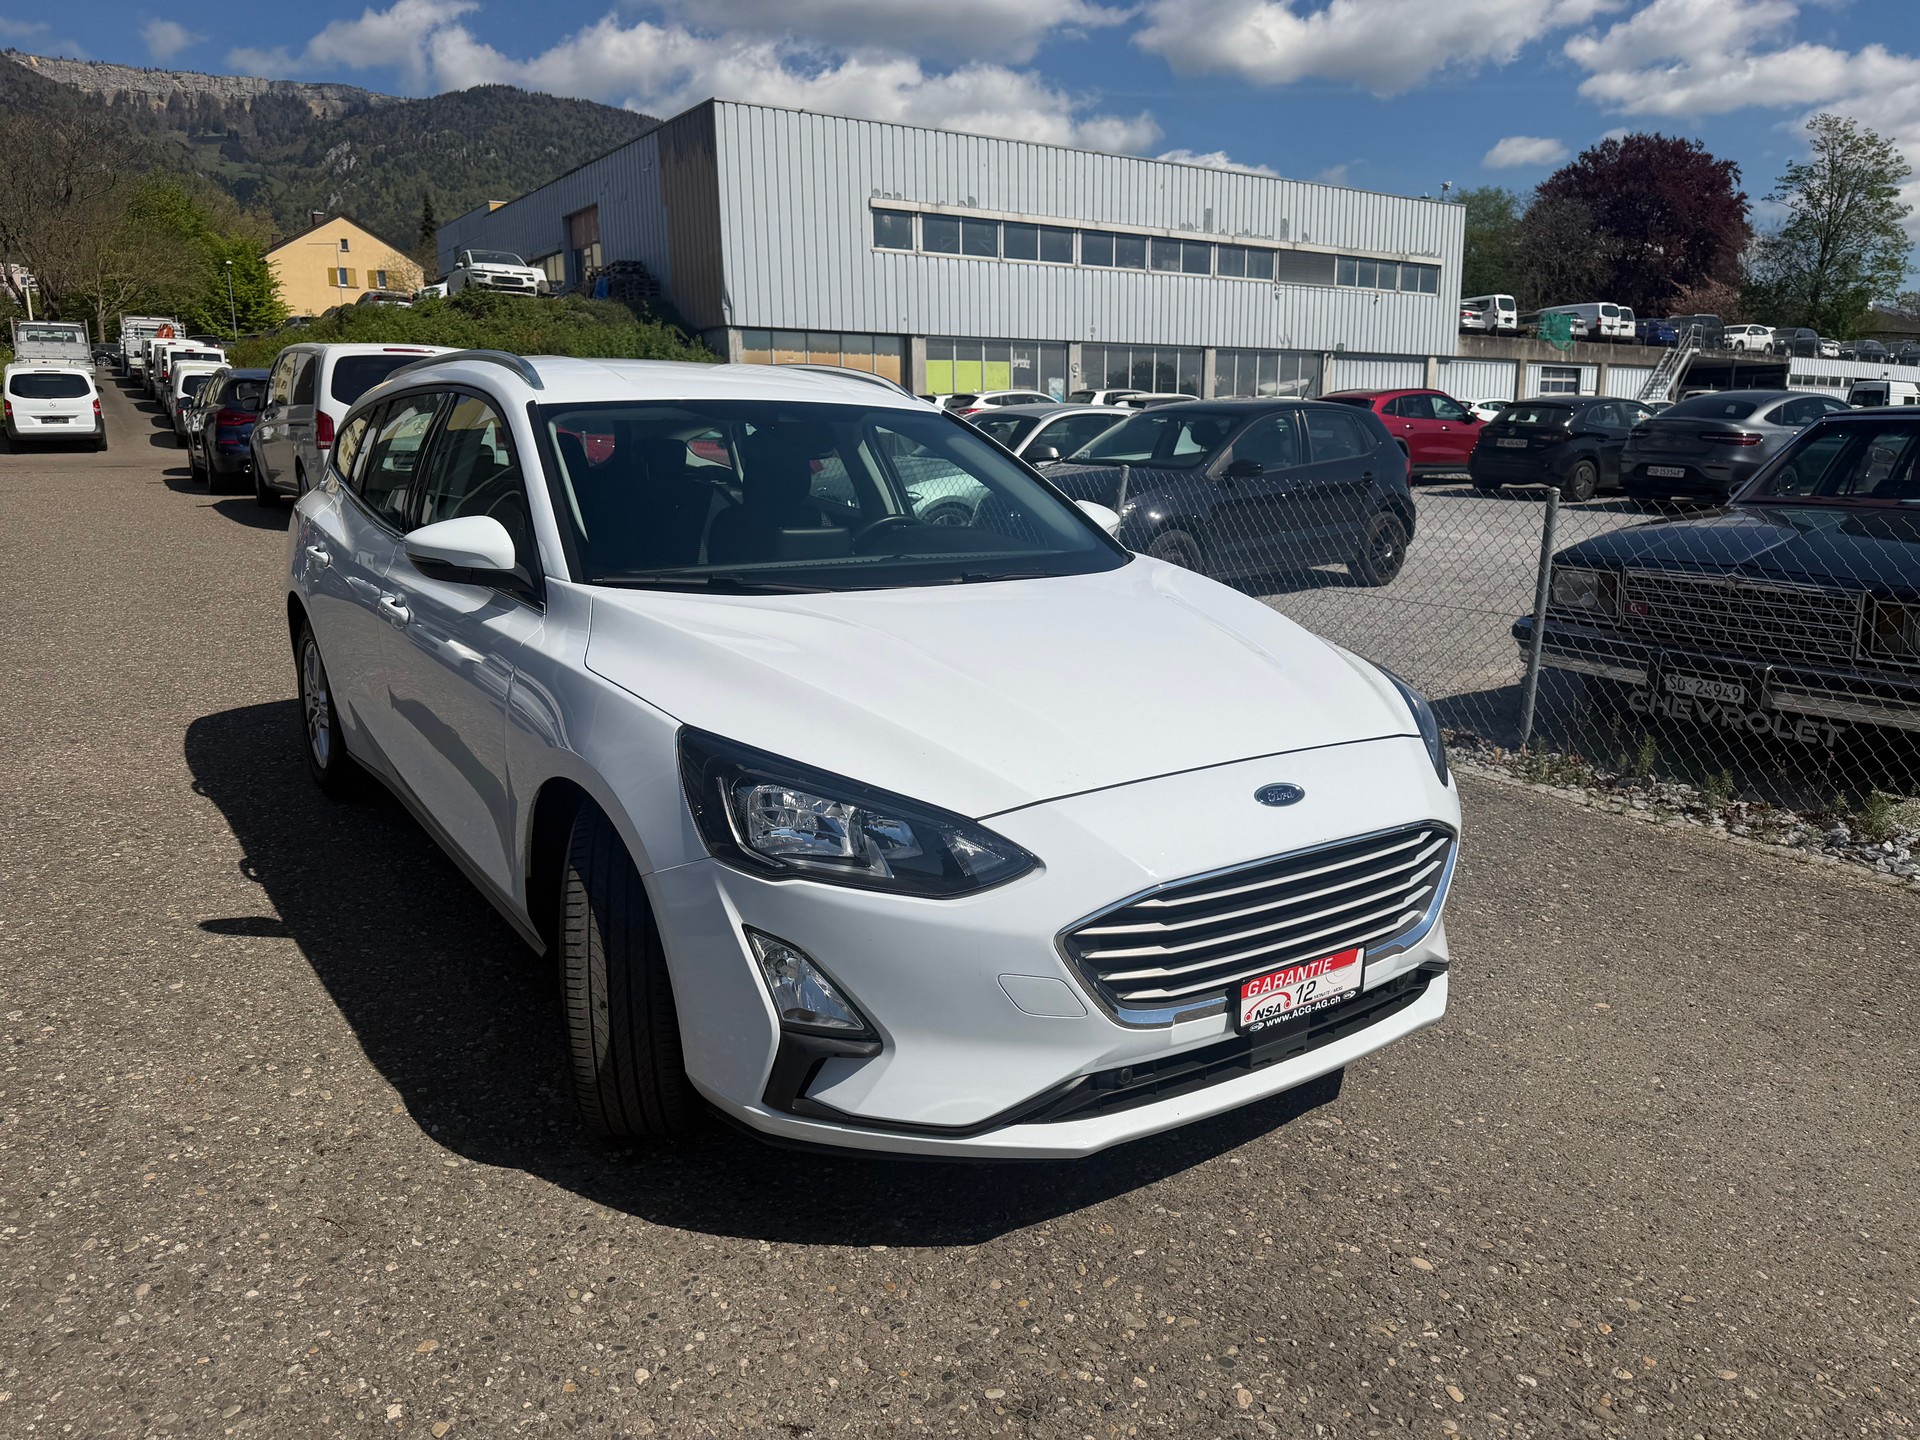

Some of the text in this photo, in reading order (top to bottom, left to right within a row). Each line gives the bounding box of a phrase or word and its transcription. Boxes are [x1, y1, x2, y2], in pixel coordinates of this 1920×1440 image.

[1628, 690, 1846, 748] CHEVROLET
[1266, 787, 1295, 803] Ford
[1247, 957, 1333, 998] GARANTIE
[1295, 980, 1317, 1005] 12
[1254, 1003, 1281, 1021] NSA
[1265, 995, 1341, 1027] www.ACG-AG.ch
